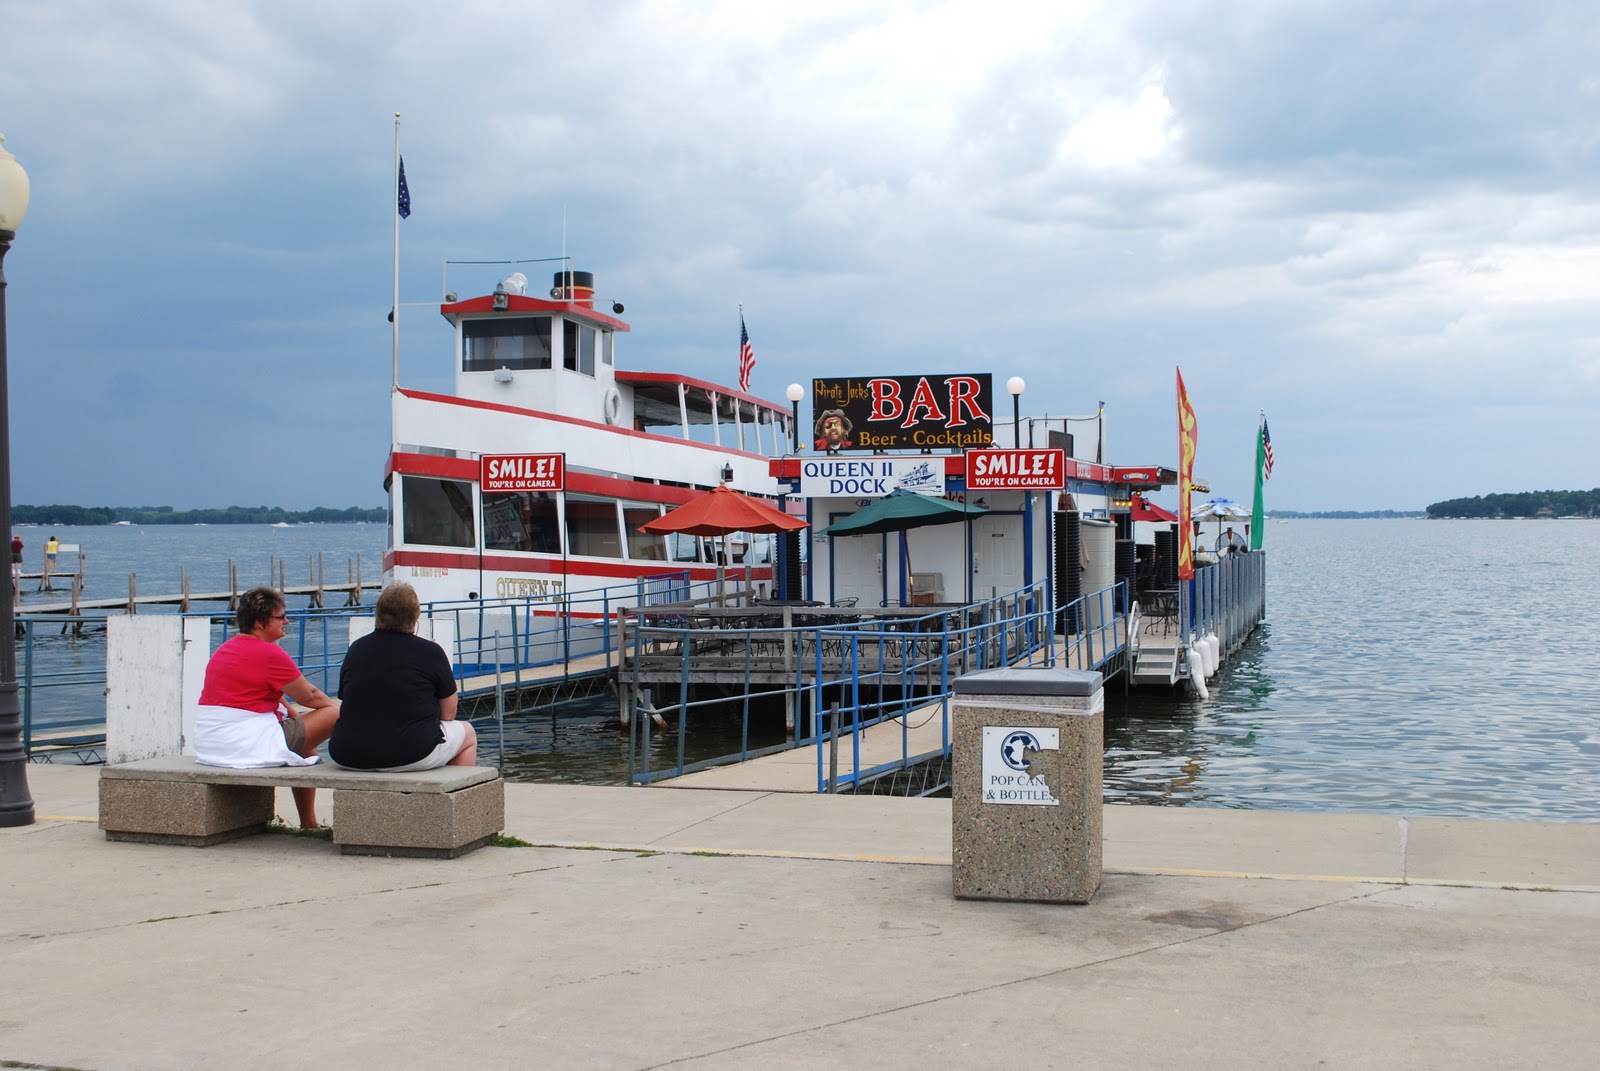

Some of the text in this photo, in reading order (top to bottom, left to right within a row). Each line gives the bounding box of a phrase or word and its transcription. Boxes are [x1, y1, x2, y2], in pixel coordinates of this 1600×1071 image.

[866, 376, 991, 428] BAR
[859, 428, 992, 447] Beer Cocktails
[488, 457, 556, 479] SMILE!
[804, 462, 893, 478] QUEEN II
[974, 452, 1056, 476] SMILE!
[488, 479, 556, 488] YOU'RE ON CAMERA
[830, 478, 887, 494] DOCK
[975, 477, 1056, 486] YOU'RE ON CAMERA
[496, 577, 564, 605] QUEEN II
[991, 775, 1046, 786] POP CAN
[986, 789, 1055, 802] & BOTTLE
